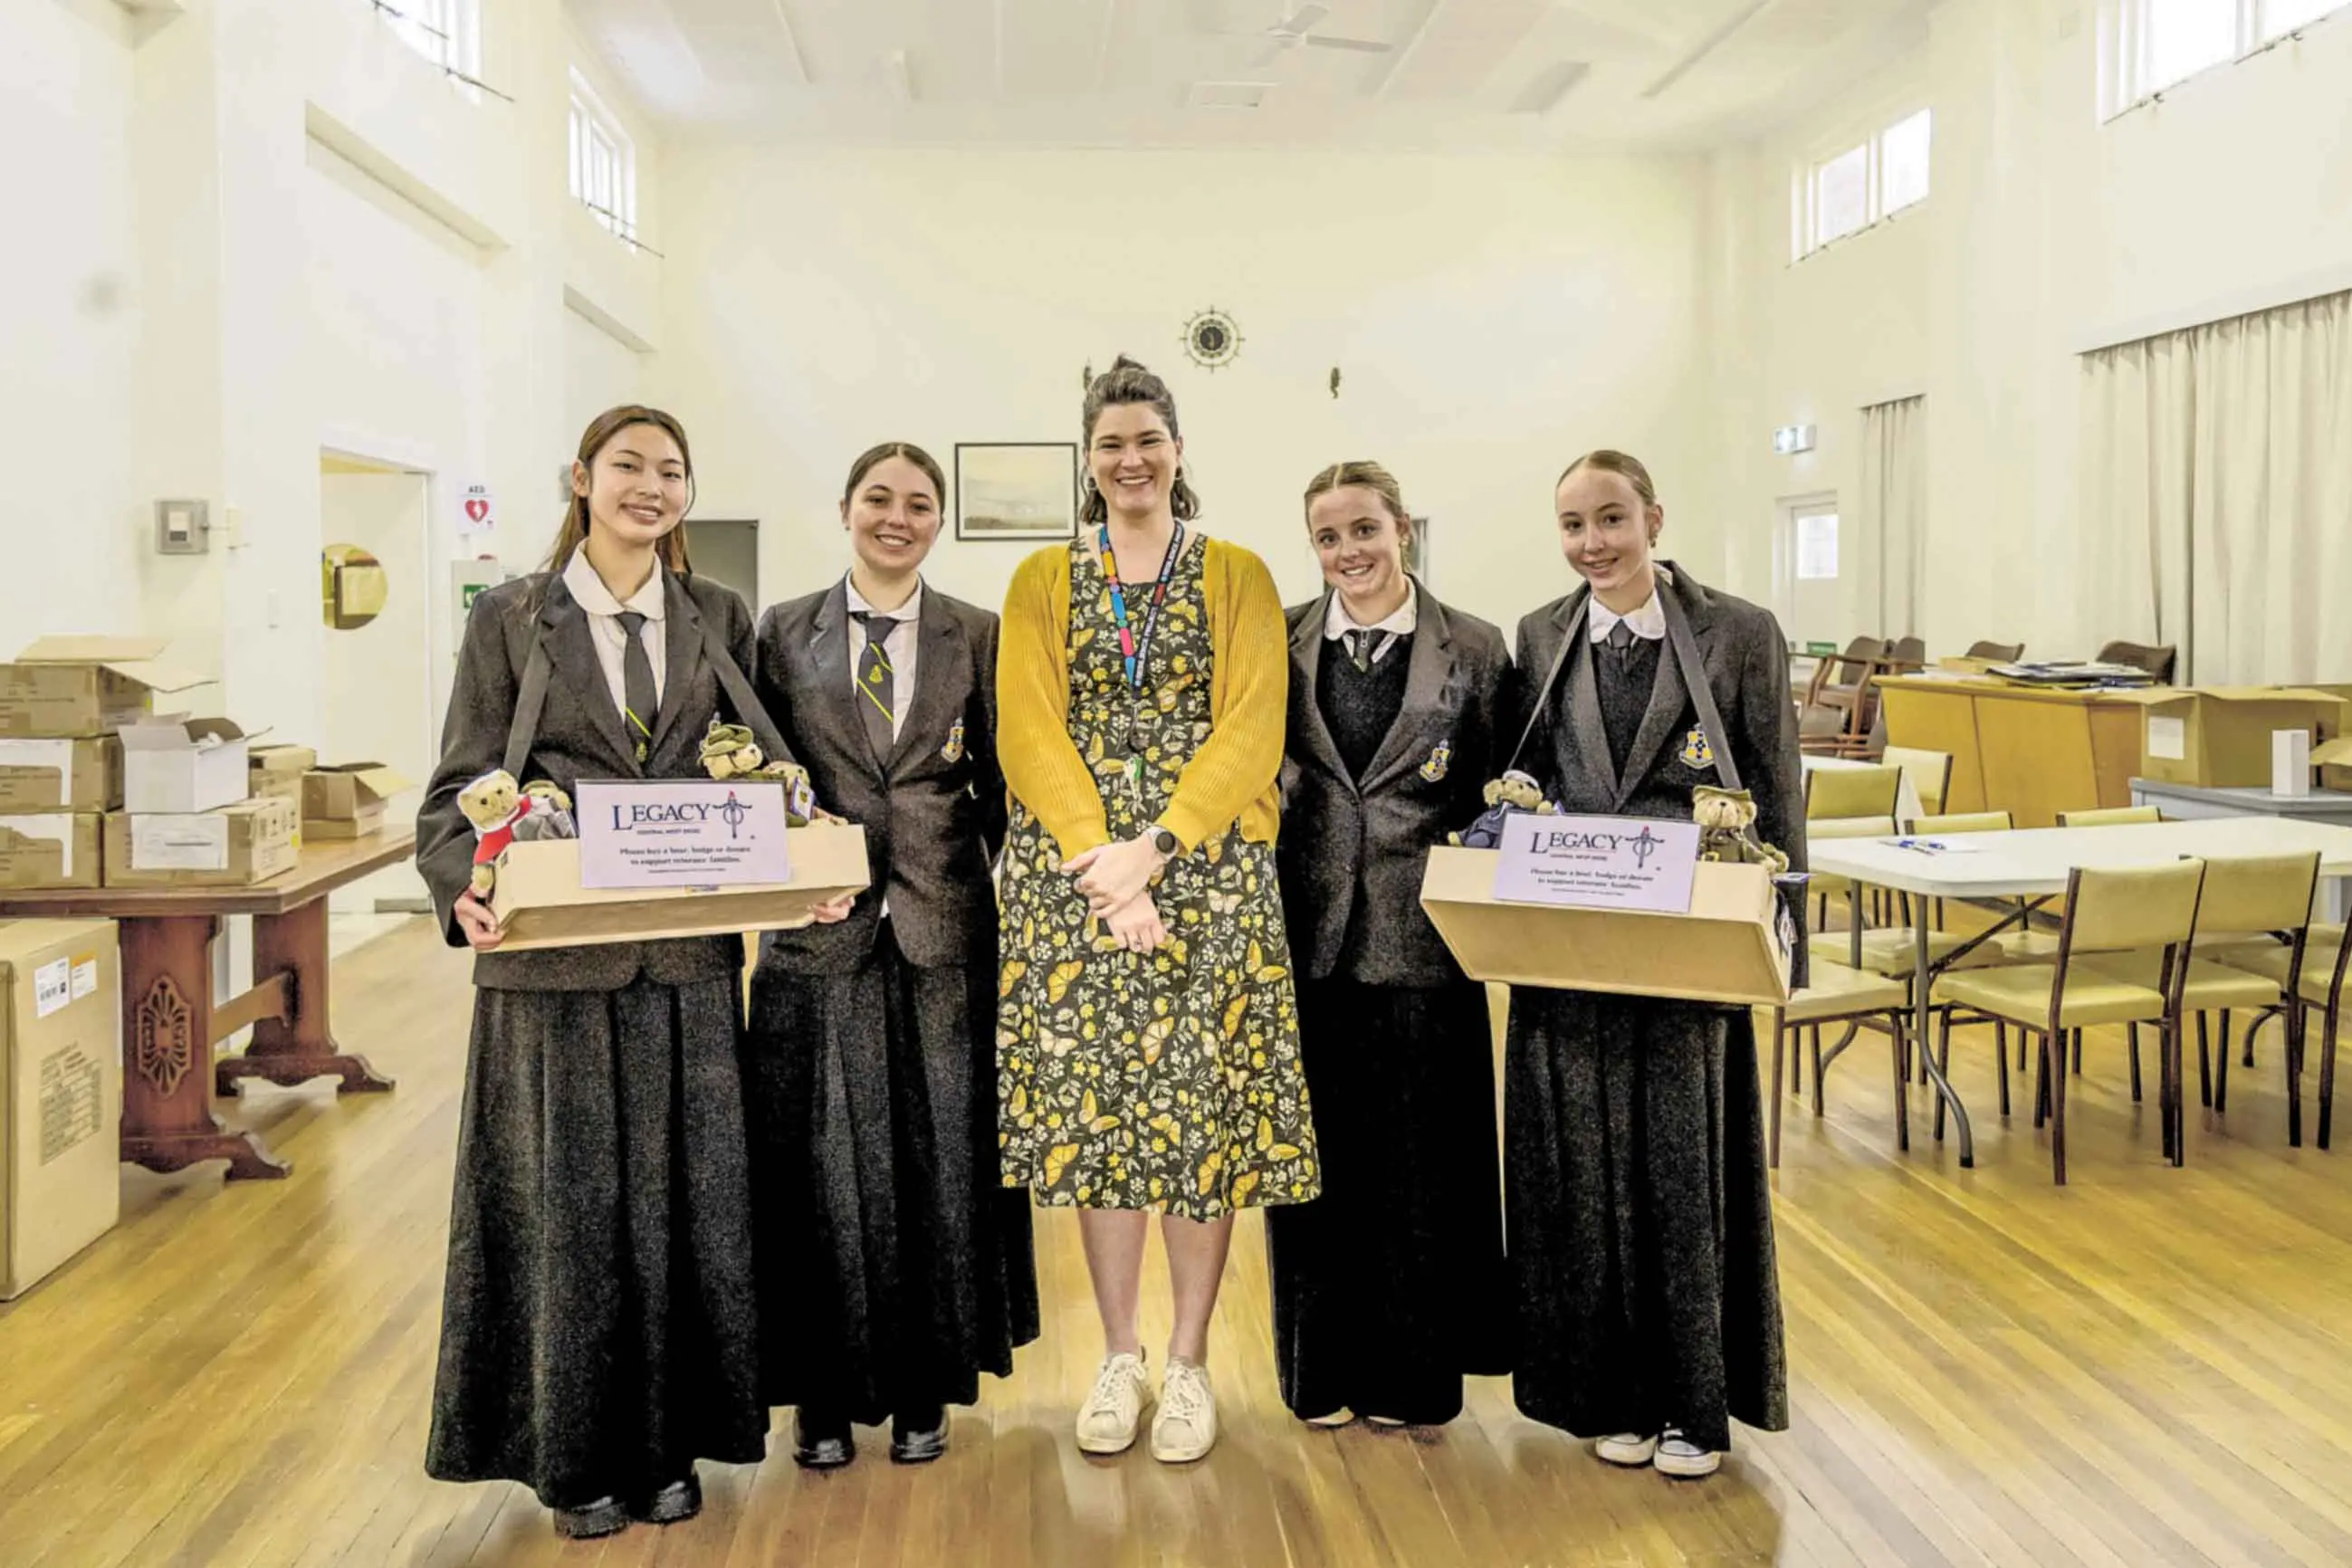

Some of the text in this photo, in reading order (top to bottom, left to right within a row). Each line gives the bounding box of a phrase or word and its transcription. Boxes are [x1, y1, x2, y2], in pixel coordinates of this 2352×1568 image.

[468, 484, 485, 493] AED
[612, 803, 710, 830] LEGACY
[1530, 831, 1623, 854] LEGACY
